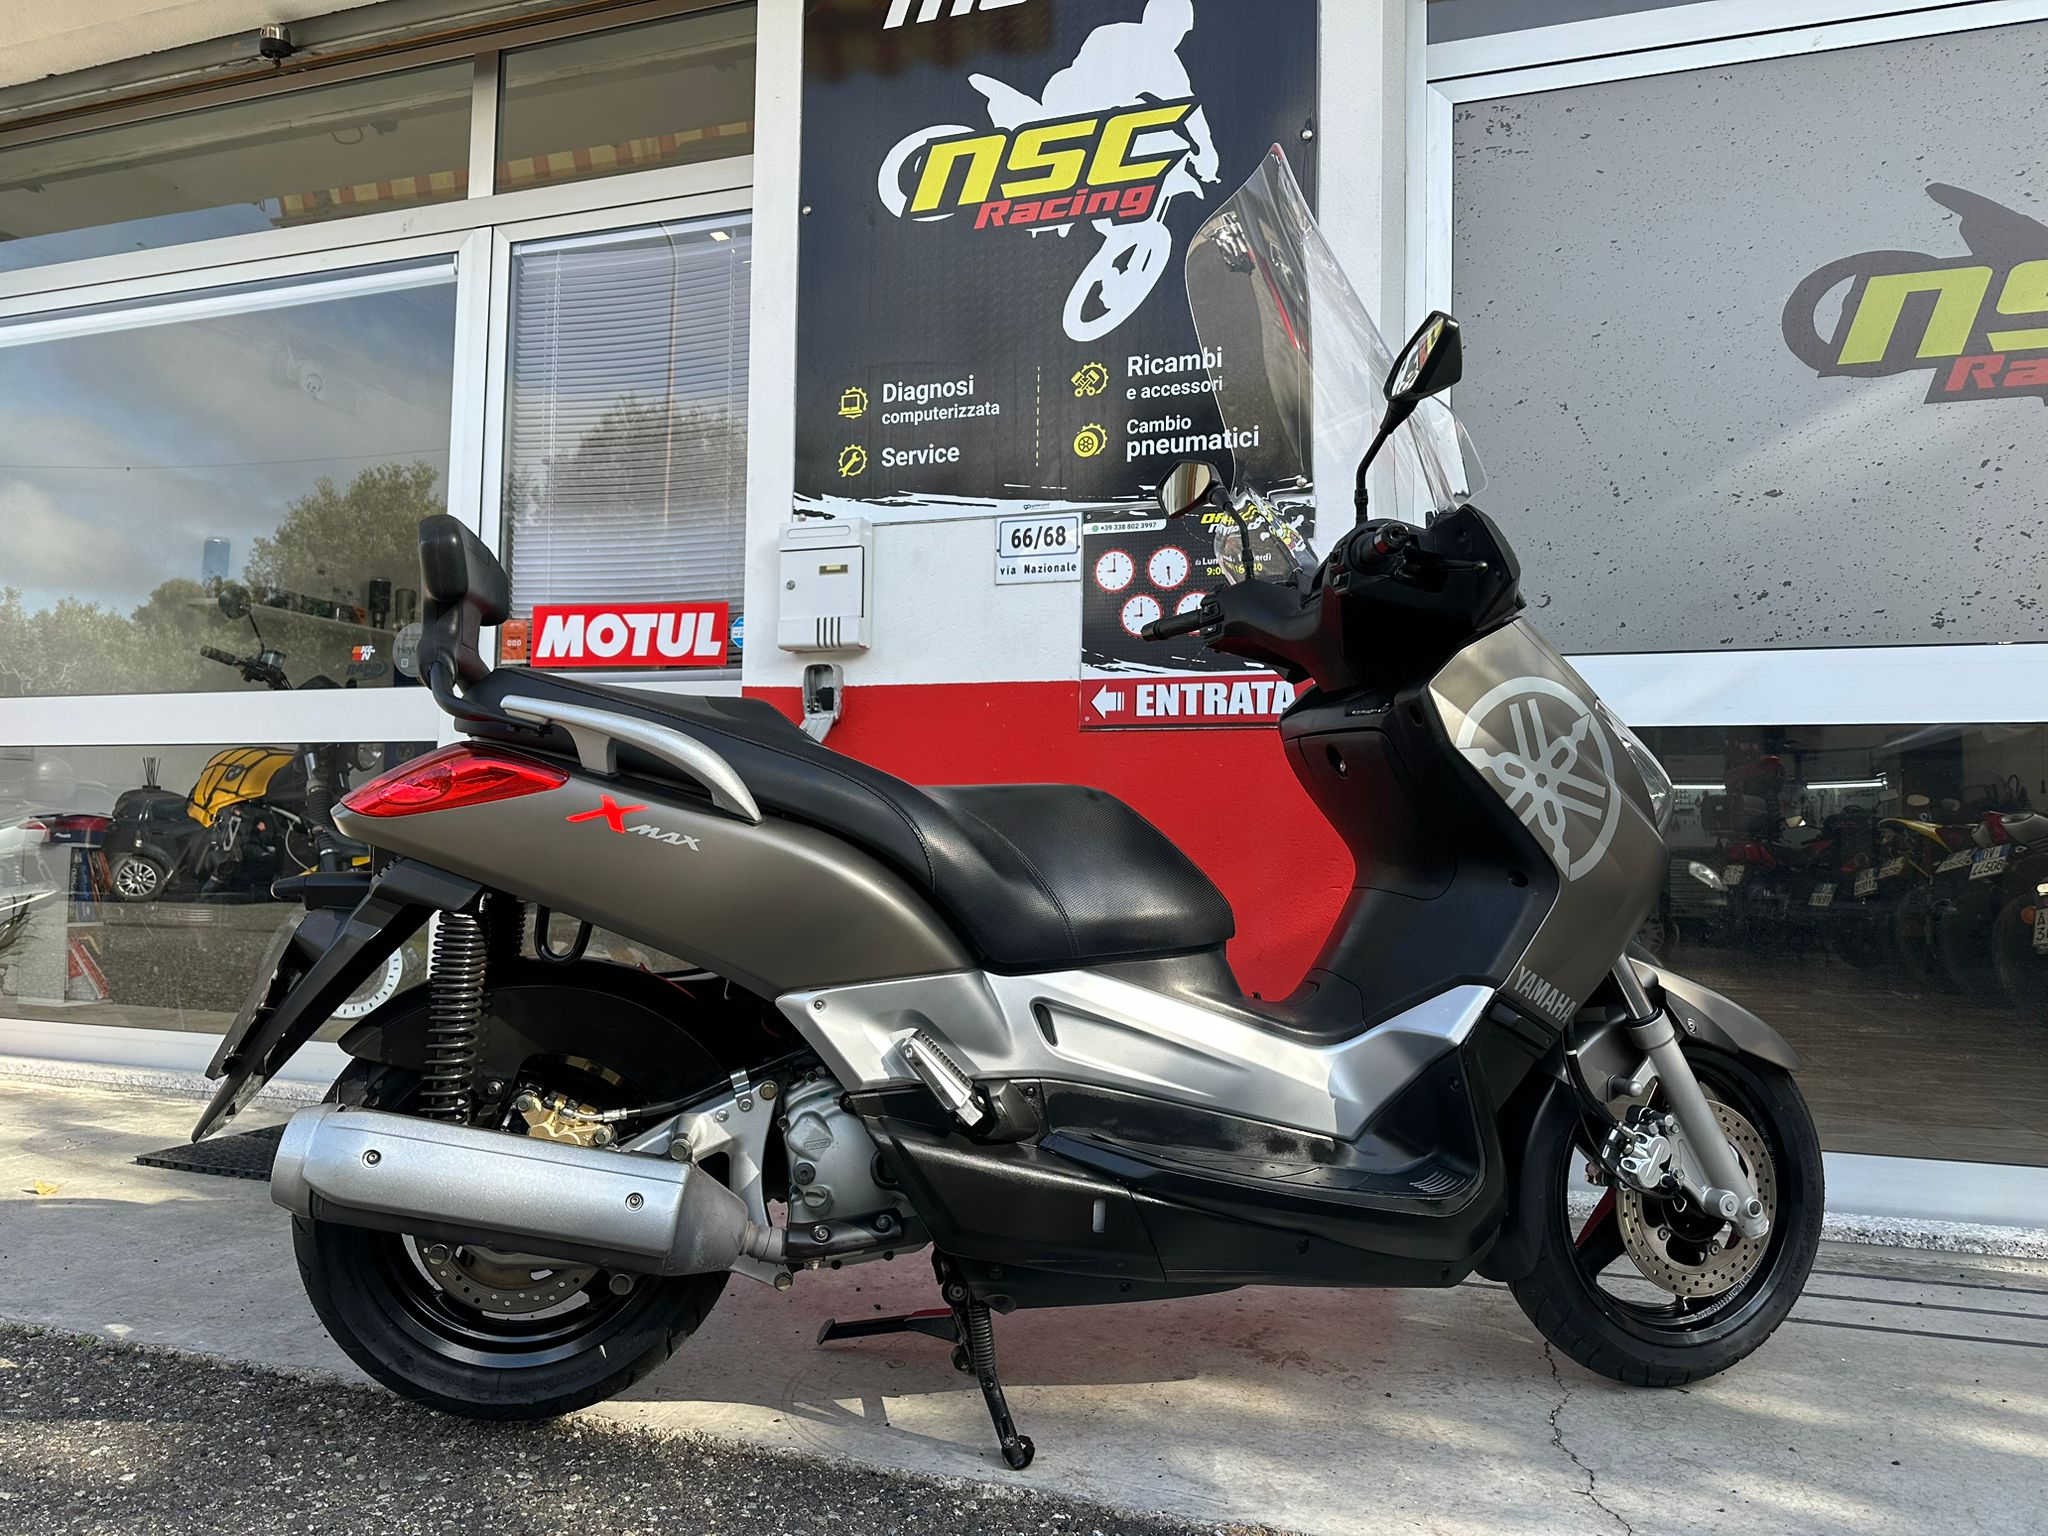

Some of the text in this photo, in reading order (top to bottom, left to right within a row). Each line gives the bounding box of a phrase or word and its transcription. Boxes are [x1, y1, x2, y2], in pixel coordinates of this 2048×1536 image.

[973, 184, 1157, 230] Racing
[1126, 347, 1224, 377] Ricambi
[881, 374, 975, 405] Diagnosi
[1126, 377, 1224, 400] e accessori
[881, 402, 1001, 427] computerizzata
[1126, 416, 1192, 435] Cambio
[881, 446, 961, 468] Service
[1126, 426, 1260, 462] pneumatici
[1010, 525, 1067, 549] 66/68
[1100, 524, 1113, 532] +39
[1114, 523, 1126, 531] 338
[1140, 521, 1157, 529] 3997
[999, 562, 1077, 576] via Nazionale
[536, 612, 721, 658] MOTUL
[1135, 681, 1297, 717] ENTRATA
[1513, 965, 1577, 1025] YAMAHA
